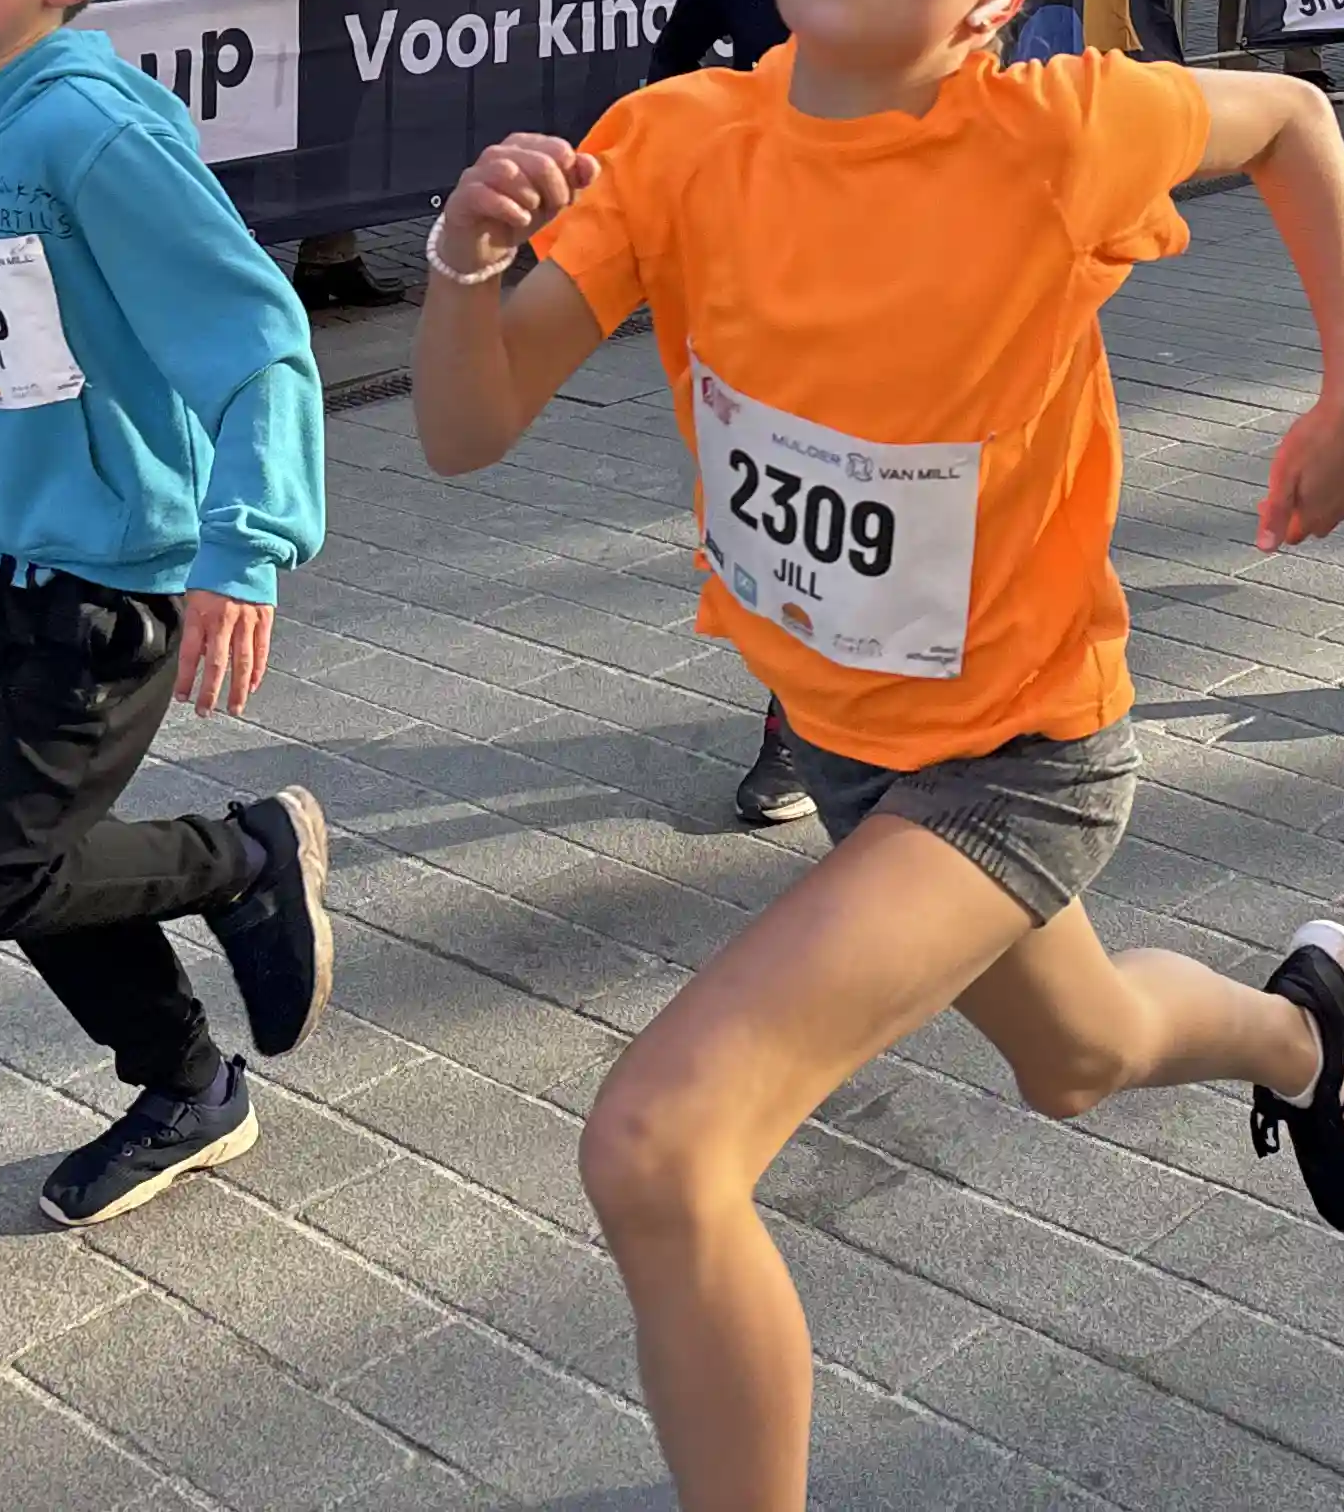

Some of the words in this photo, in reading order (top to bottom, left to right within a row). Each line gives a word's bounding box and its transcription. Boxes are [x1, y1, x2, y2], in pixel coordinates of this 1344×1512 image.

[344, 9, 521, 82] Voor
[879, 467, 915, 481] VAN
[917, 466, 961, 480] MILL
[729, 448, 896, 578] 2309
[773, 557, 823, 602] JILL
